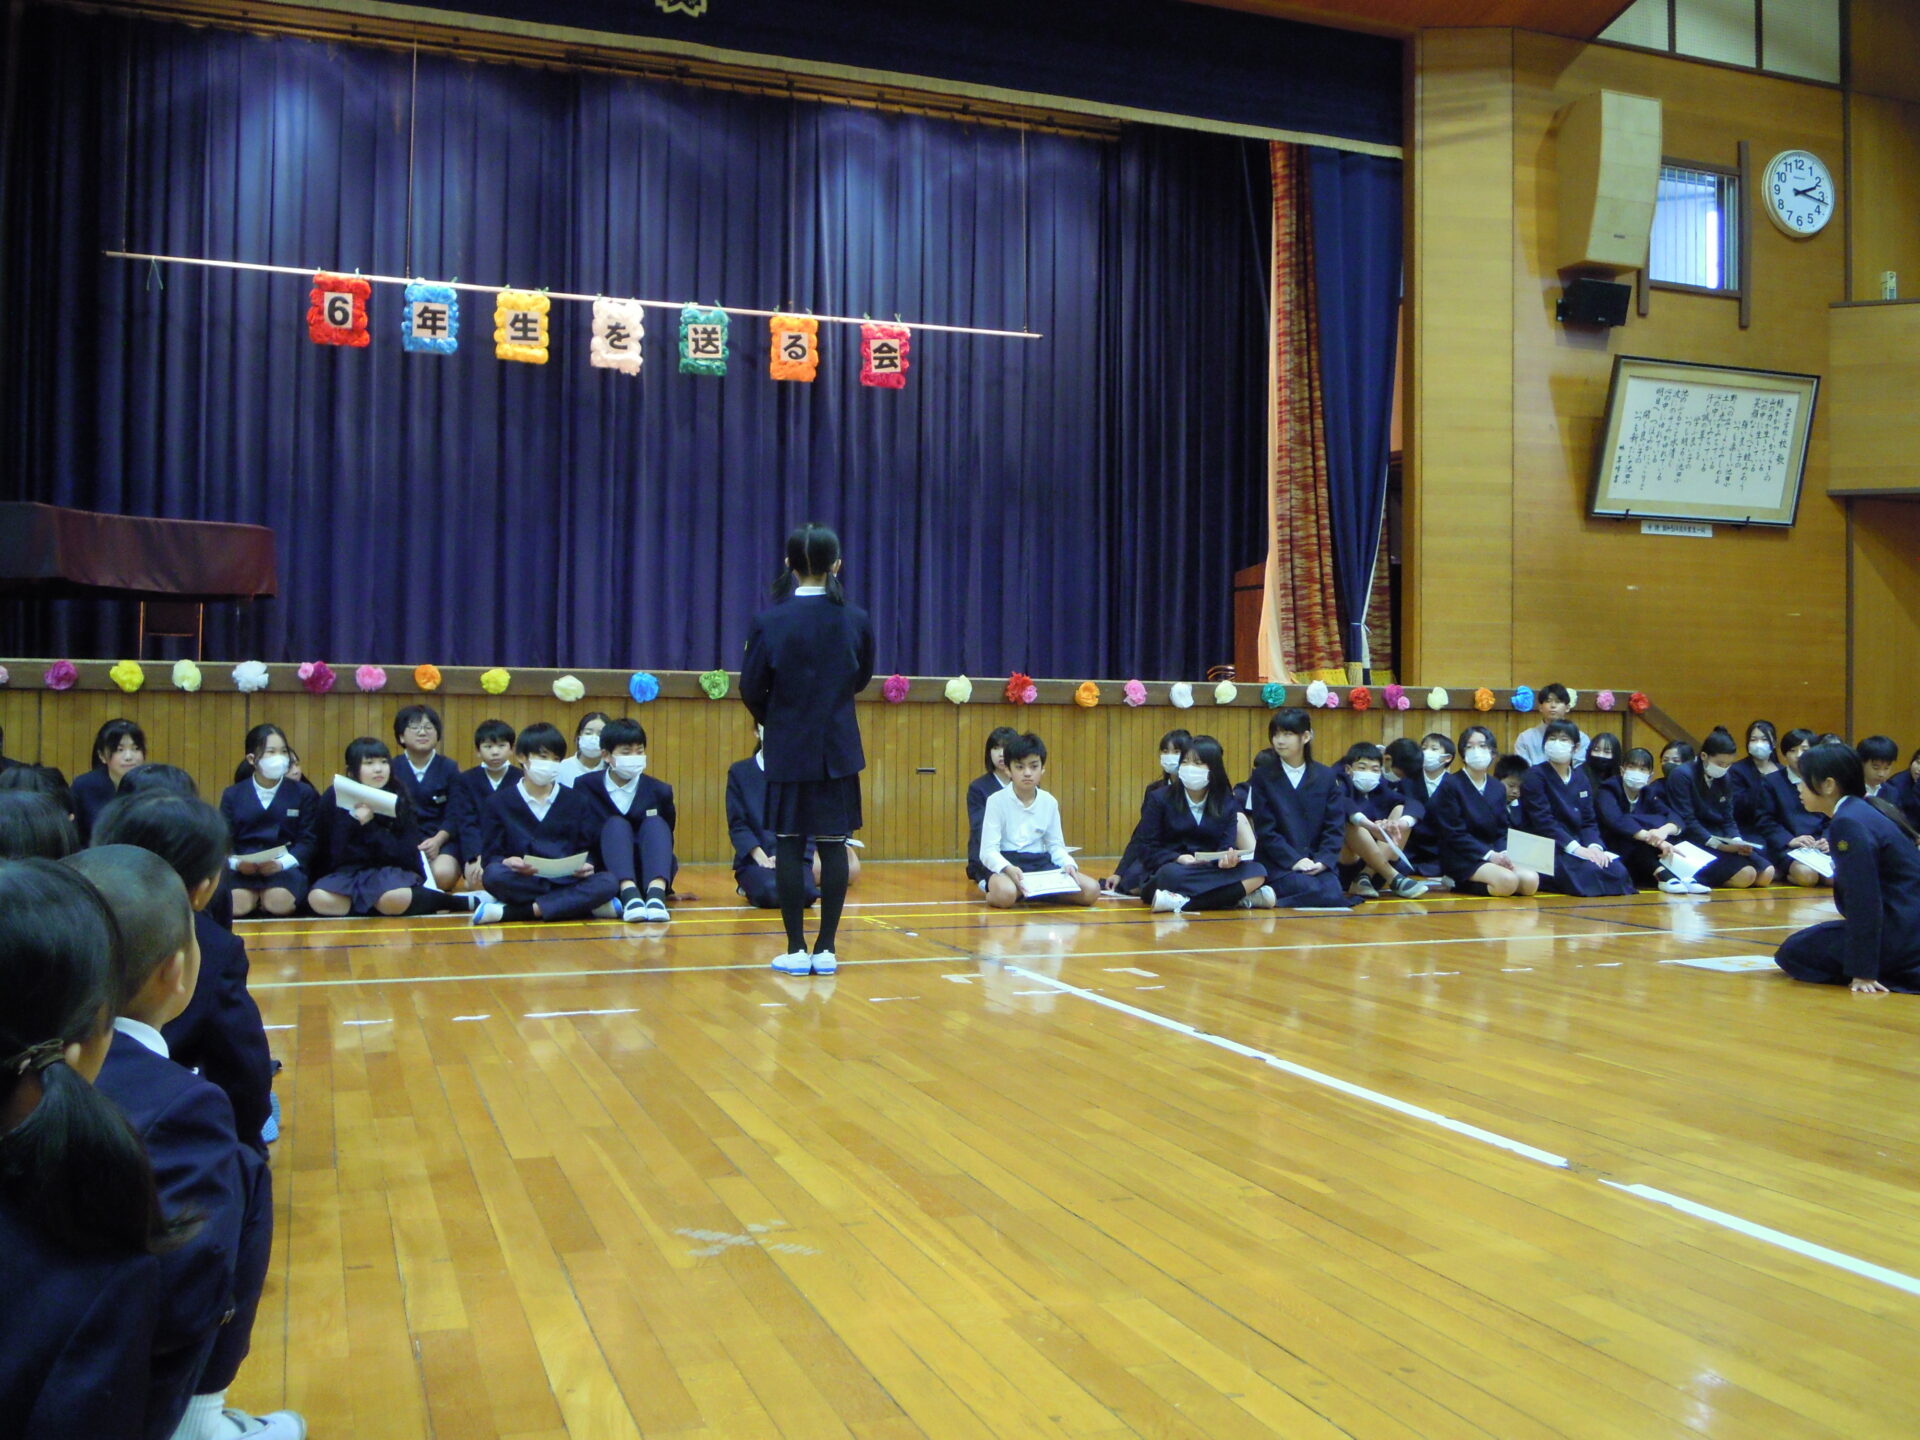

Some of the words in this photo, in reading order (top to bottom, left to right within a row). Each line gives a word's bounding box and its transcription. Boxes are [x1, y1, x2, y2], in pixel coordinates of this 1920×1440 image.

[1784, 162, 1792, 173] 11
[1794, 159, 1804, 170] 12
[1808, 167, 1813, 176] 1
[1776, 172, 1786, 183] 10
[1815, 177, 1821, 187] 2
[1774, 185, 1780, 195] 9
[1819, 192, 1824, 201] 3
[1778, 199, 1784, 209] 8
[1815, 205, 1821, 215] 4
[1787, 210, 1793, 221] 7
[1807, 213, 1813, 224] 5
[1797, 216, 1803, 226] 6
[327, 294, 901, 371] 6年生を送る会
